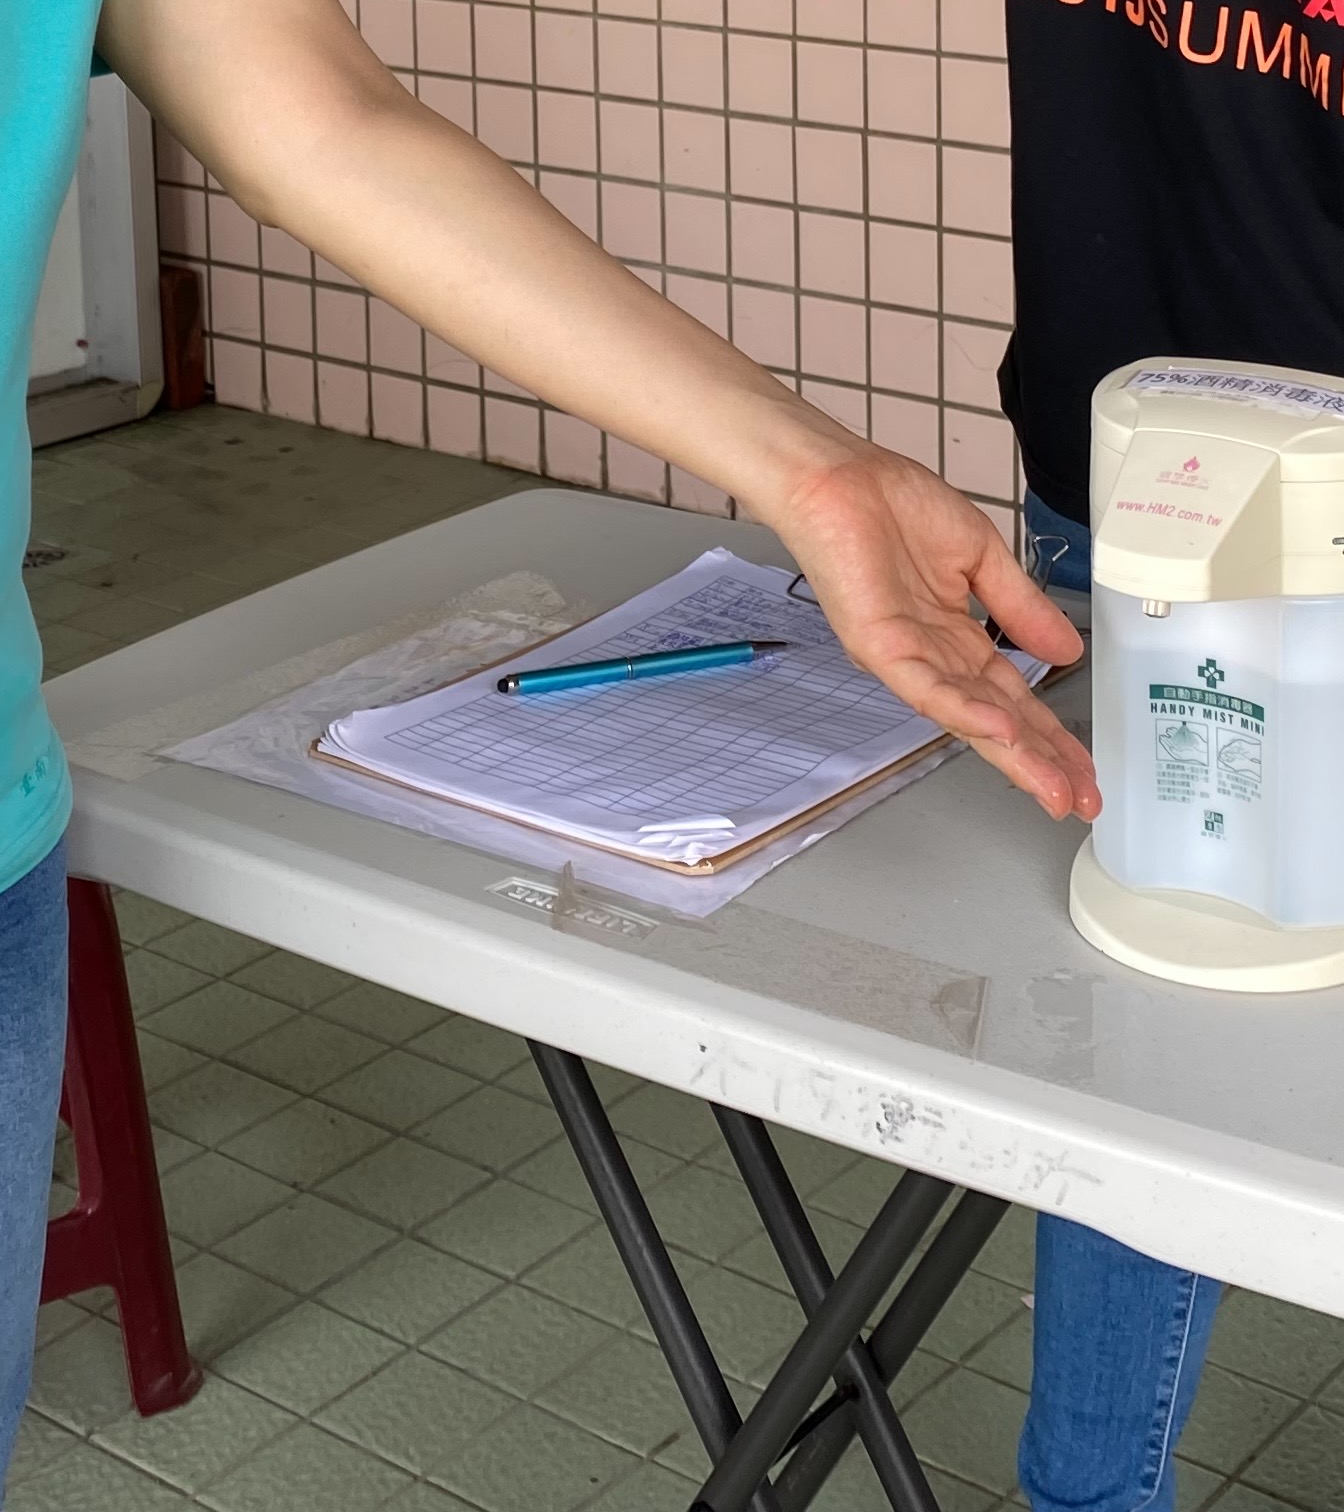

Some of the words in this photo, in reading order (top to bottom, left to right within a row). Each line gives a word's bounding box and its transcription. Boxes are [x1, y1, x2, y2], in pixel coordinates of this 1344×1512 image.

[1150, 702, 1196, 718] HANDY
[1202, 707, 1234, 726] MIST
[1240, 717, 1265, 737] MINI
